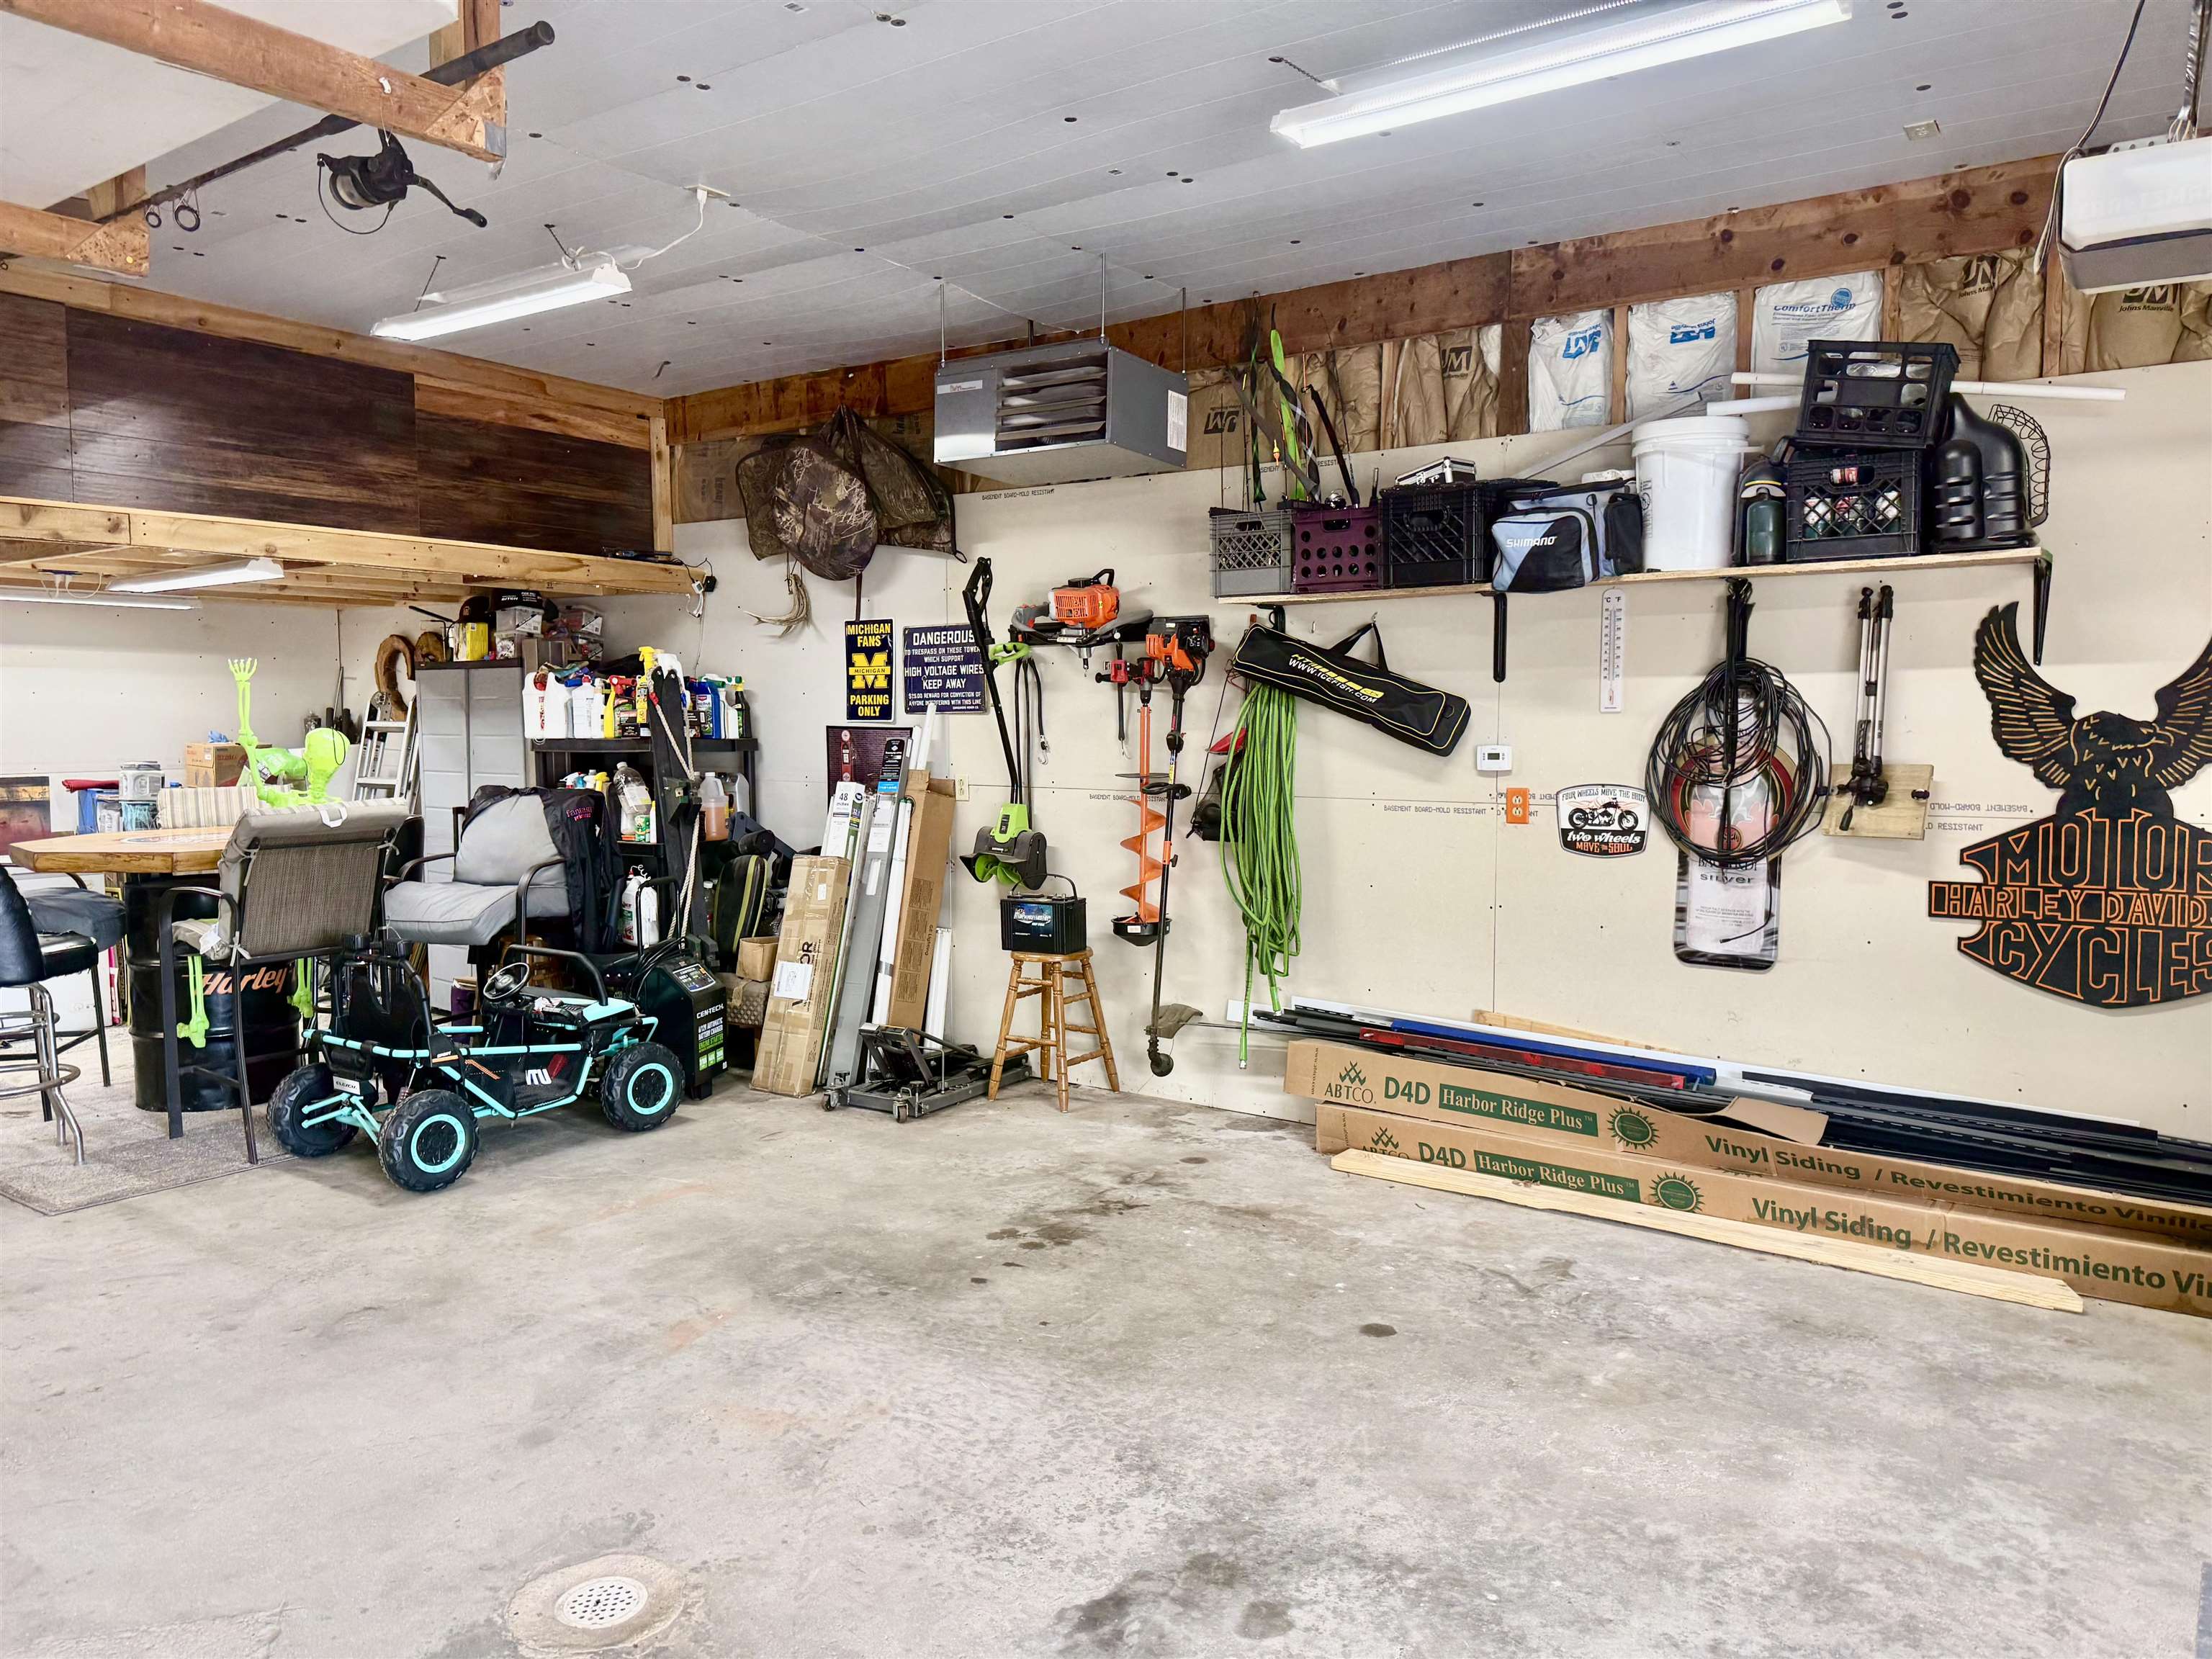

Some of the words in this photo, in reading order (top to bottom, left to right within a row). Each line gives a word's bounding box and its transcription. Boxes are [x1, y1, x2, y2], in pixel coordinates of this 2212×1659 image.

[1506, 536, 1557, 547] SHIMANO
[847, 623, 891, 635] MICHIGAN
[857, 635, 881, 647] FANS
[913, 629, 975, 646] DANGEROUS
[904, 666, 922, 677] HIGH
[924, 665, 958, 676] VOLTAGE
[959, 664, 984, 675] WIRES
[922, 679, 942, 690] KEEP
[945, 678, 966, 689] AWAY
[1289, 657, 1377, 703] WWW.ICEFISH.COM
[850, 694, 889, 706] PARKING
[858, 706, 881, 716] ONLY
[839, 793, 848, 801] 48
[1562, 791, 1576, 801] FOUR
[1578, 788, 1599, 797] WHEELS
[1601, 788, 1617, 797] MOVE
[1619, 789, 1630, 799] THE
[1632, 791, 1646, 802] BODY
[1384, 804, 1412, 813] BASEMENT
[1414, 806, 1451, 814] BOARD-MOLD
[1985, 803, 2028, 813] BASEMENT
[1938, 823, 1984, 832] RESISTANT
[1567, 831, 1592, 842] two
[1594, 831, 1642, 844] wheels
[1575, 842, 1600, 853] MOVE
[1609, 842, 1633, 853] SOUL
[924, 934, 932, 956] Lighting
[696, 1003, 724, 1019] CEN-TECH
[1384, 1076, 1431, 1105] D4D
[1442, 1087, 1498, 1113] Harbor
[1501, 1098, 1545, 1125] Ridge
[1550, 1107, 1583, 1129] Plus
[1418, 1141, 1467, 1169] D4D
[1478, 1154, 1535, 1177] Harbor
[1539, 1165, 1585, 1189] Ridge
[1590, 1173, 1624, 1195] Plus
[1706, 1134, 1770, 1164] Vinyl
[1774, 1151, 1861, 1180] Siding
[1890, 1170, 2108, 1216] Revestimiento
[1752, 1197, 1817, 1230] Vinyl
[1825, 1210, 1912, 1251] Siding
[1944, 1232, 2166, 1290] Revestimiento
